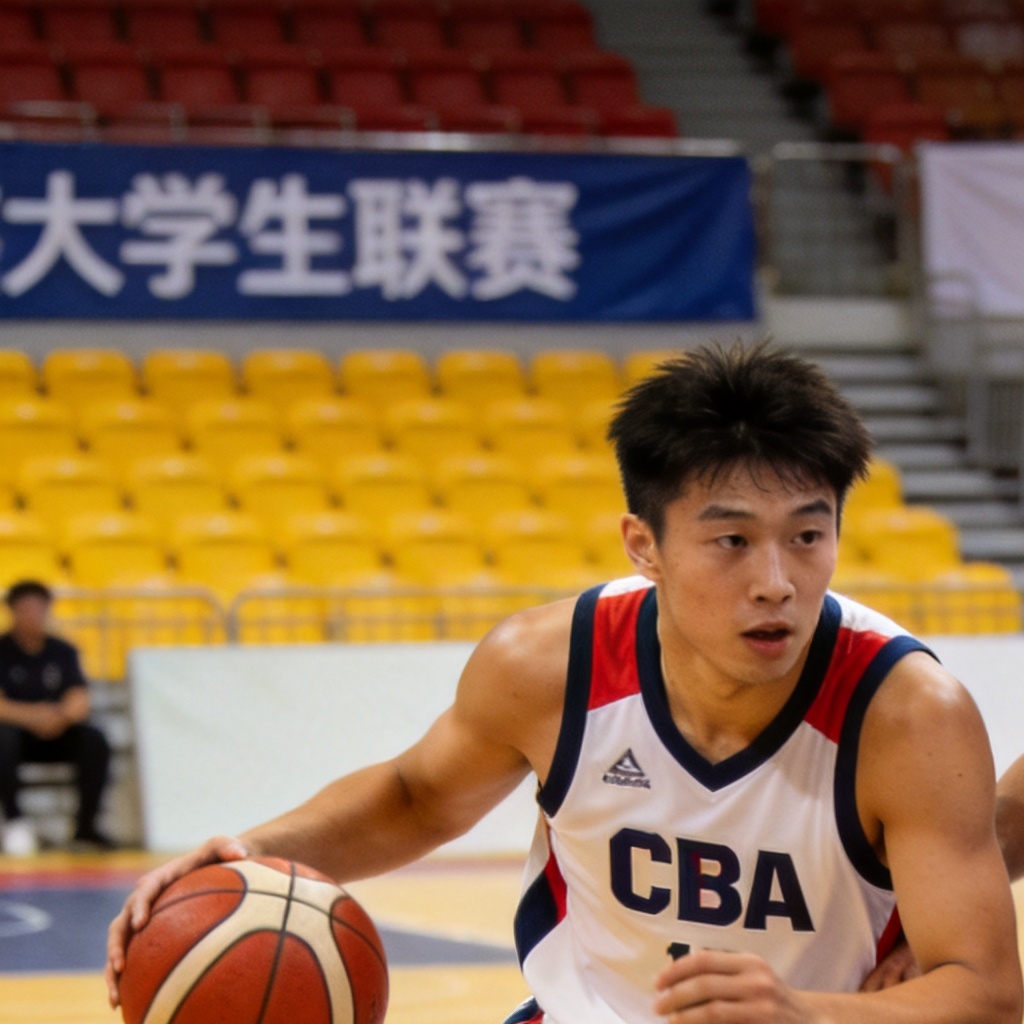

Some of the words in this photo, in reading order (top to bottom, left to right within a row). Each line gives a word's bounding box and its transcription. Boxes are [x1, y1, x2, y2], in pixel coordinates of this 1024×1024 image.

[0, 170, 579, 300] 大学生联赛
[609, 827, 816, 932] CBA
